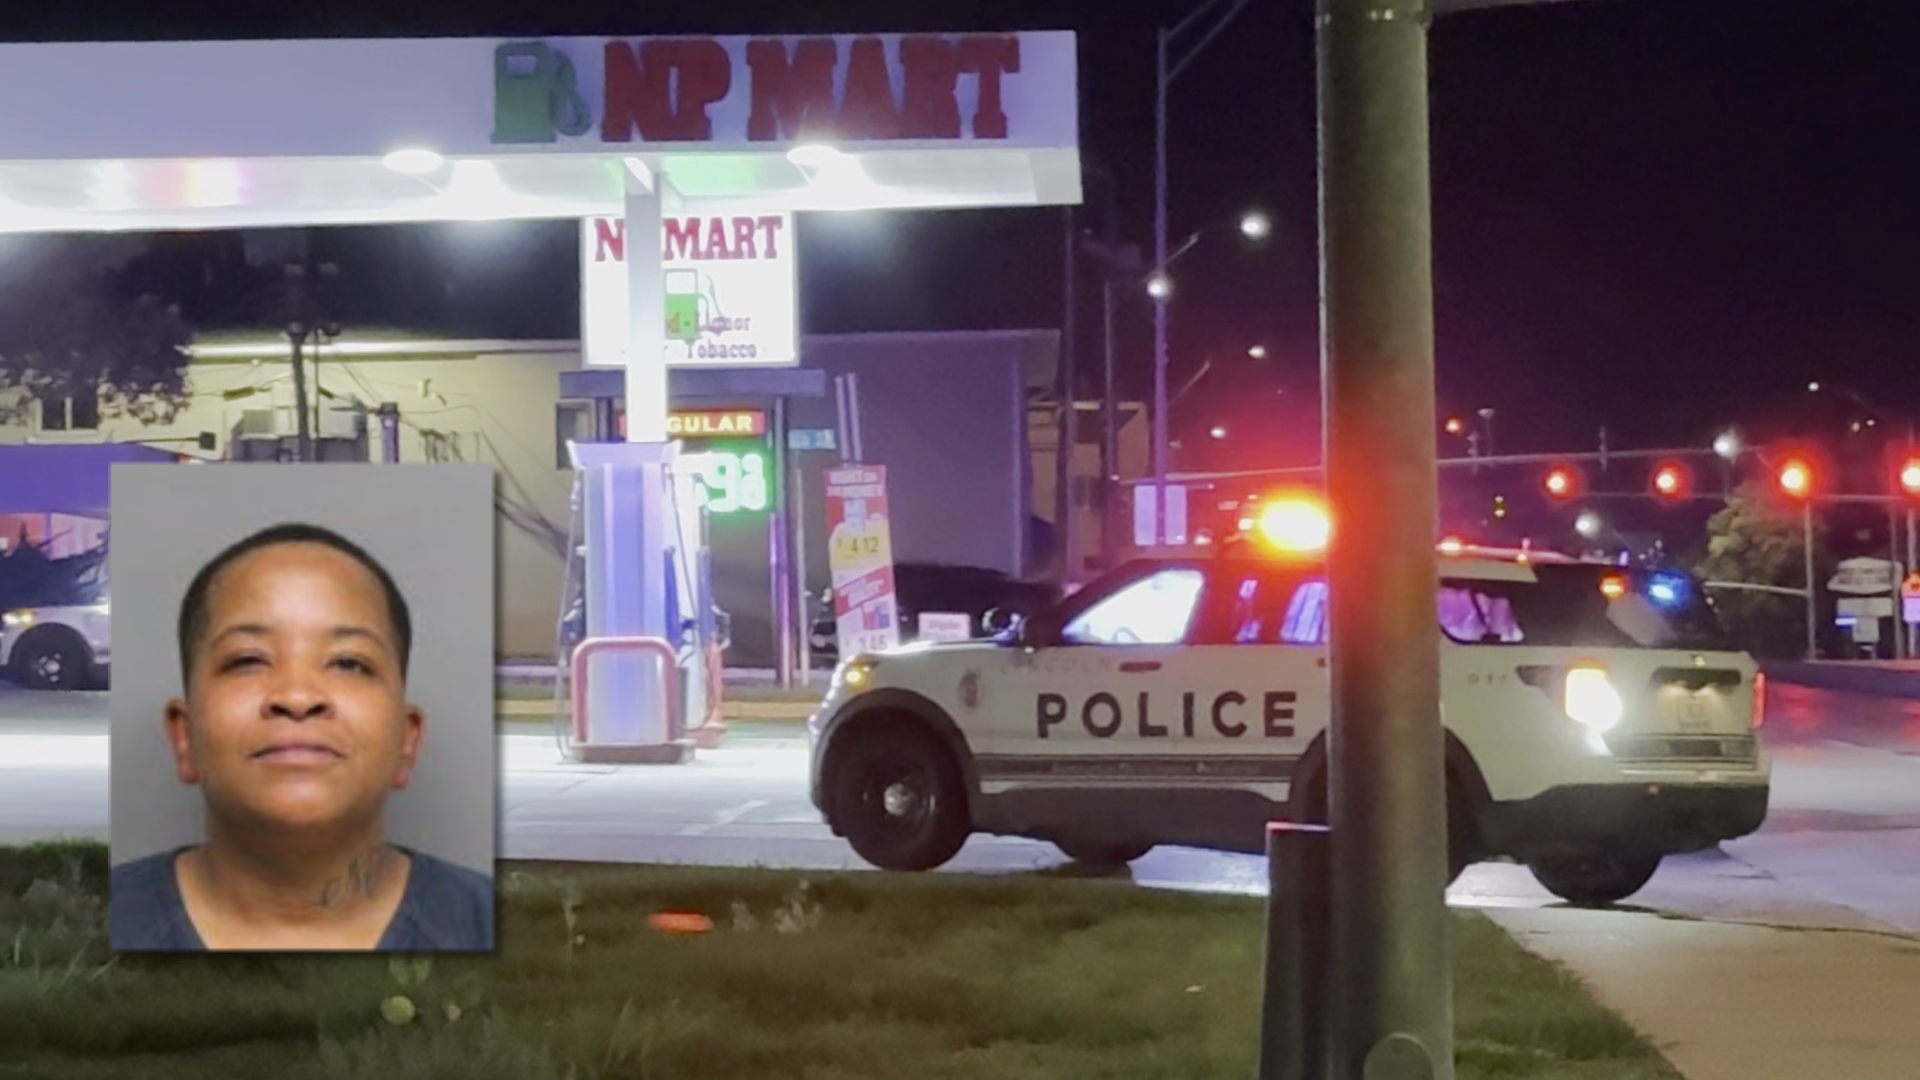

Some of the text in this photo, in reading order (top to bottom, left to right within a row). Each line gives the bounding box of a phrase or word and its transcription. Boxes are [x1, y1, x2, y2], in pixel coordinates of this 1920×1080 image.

[602, 36, 1021, 142] NP MART
[594, 215, 783, 262] N MART
[666, 413, 753, 432] GULAR
[1037, 691, 1297, 739] POLICE
